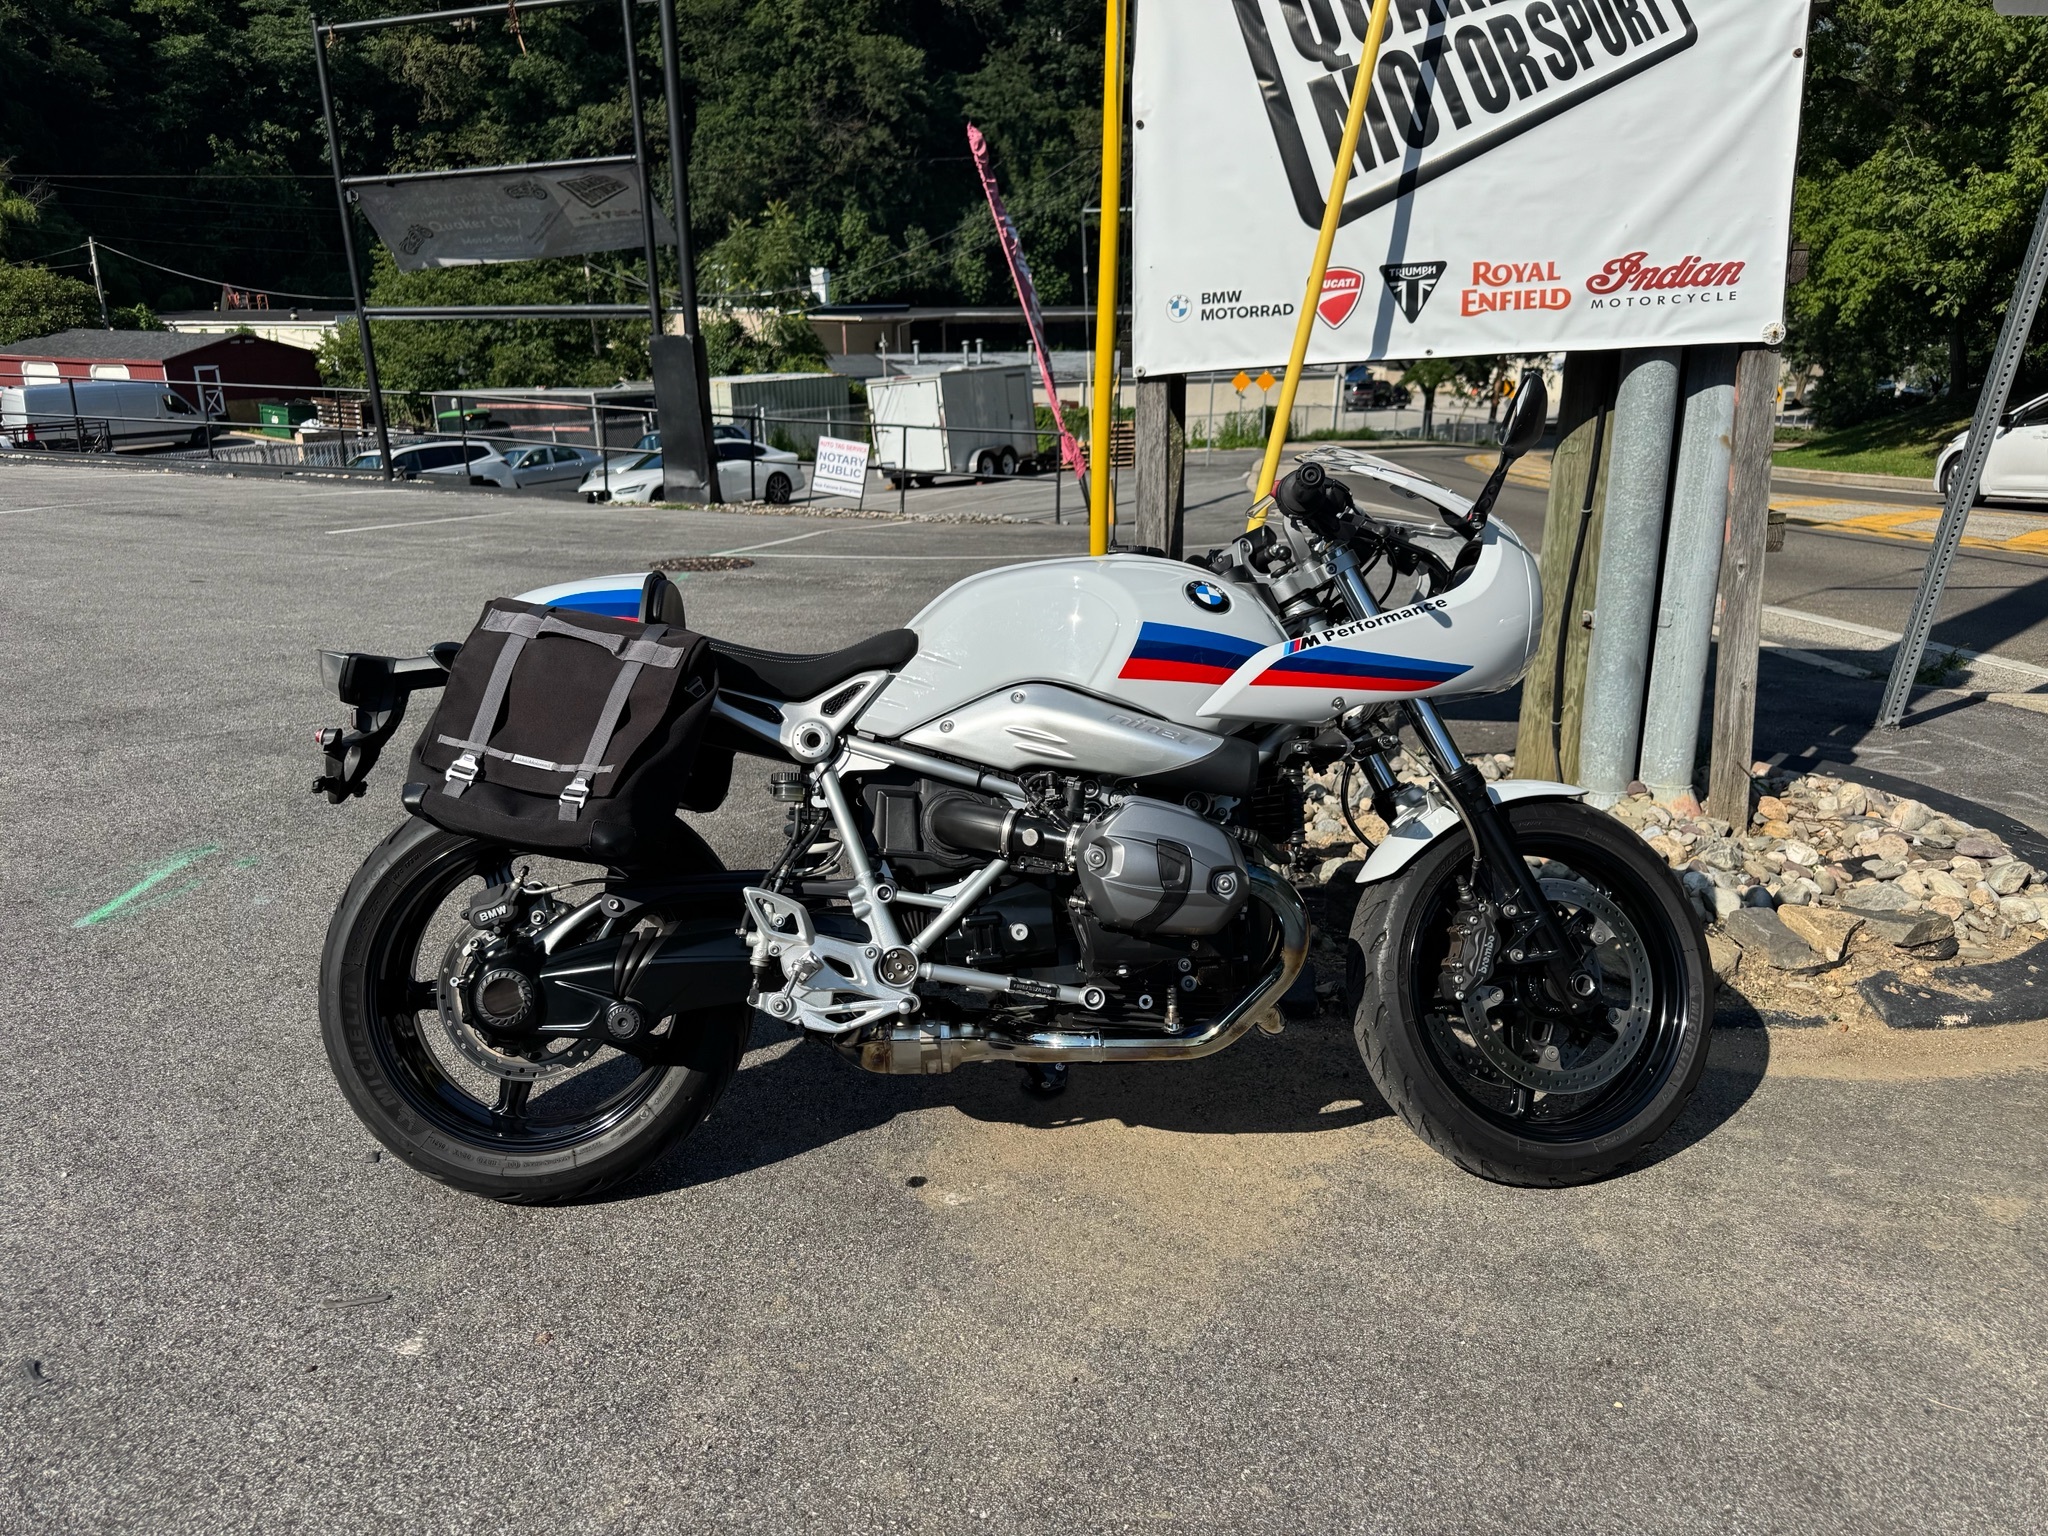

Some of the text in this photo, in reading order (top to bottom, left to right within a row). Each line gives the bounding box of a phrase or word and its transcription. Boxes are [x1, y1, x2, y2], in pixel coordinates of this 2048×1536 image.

[428, 215, 521, 232] Quaker City
[1388, 265, 1437, 277] TRIUMPH
[1472, 261, 1561, 286] ROYAL
[1586, 251, 1745, 294] Indian
[1322, 277, 1356, 289] UCATI
[1201, 290, 1242, 305] BMW
[1461, 287, 1571, 317] ENFIELD
[1590, 291, 1737, 309] MOTORCYCLE
[1201, 303, 1294, 321] MOTORRAD
[820, 441, 834, 449] AUTO
[846, 445, 868, 453] SERVICE
[819, 451, 865, 467] NOTARY
[819, 463, 861, 478] PUBLIC
[1301, 599, 1448, 650] M Performance
[479, 905, 506, 922] BMW
[1478, 935, 1495, 974] brembo
[344, 981, 397, 1107] MICHELIN
[1673, 1001, 1700, 1079] MICHELIN
